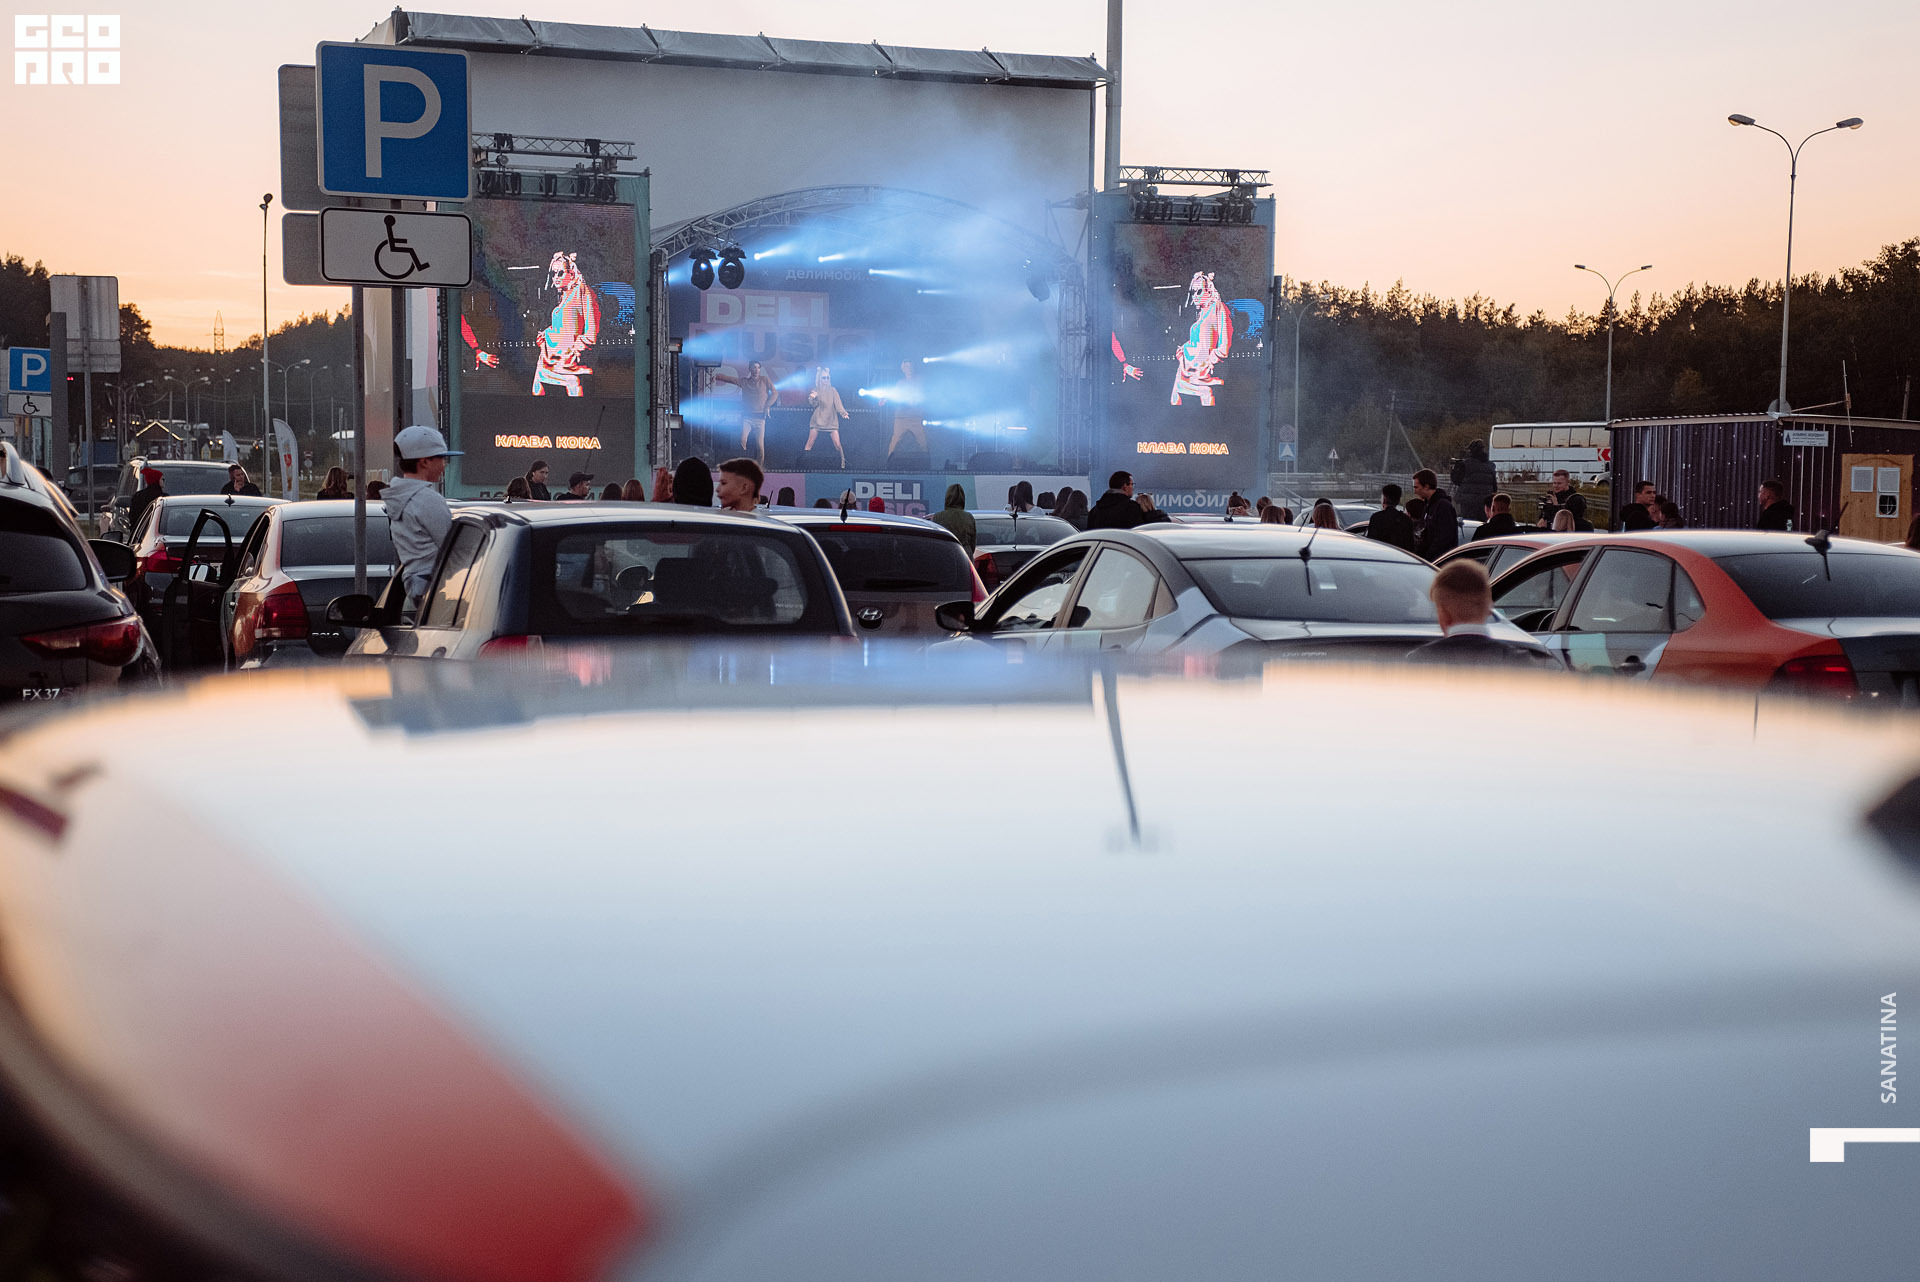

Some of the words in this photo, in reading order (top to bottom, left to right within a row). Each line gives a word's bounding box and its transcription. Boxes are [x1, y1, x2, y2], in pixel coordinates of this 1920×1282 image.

[364, 63, 442, 178] P
[706, 293, 824, 328] DELI
[21, 353, 47, 387] P
[495, 434, 552, 448] КЛАВА
[556, 436, 602, 449] КОКА
[1137, 441, 1187, 454] КЛАВА
[1189, 443, 1230, 455] КОКА
[855, 481, 921, 500] DELI
